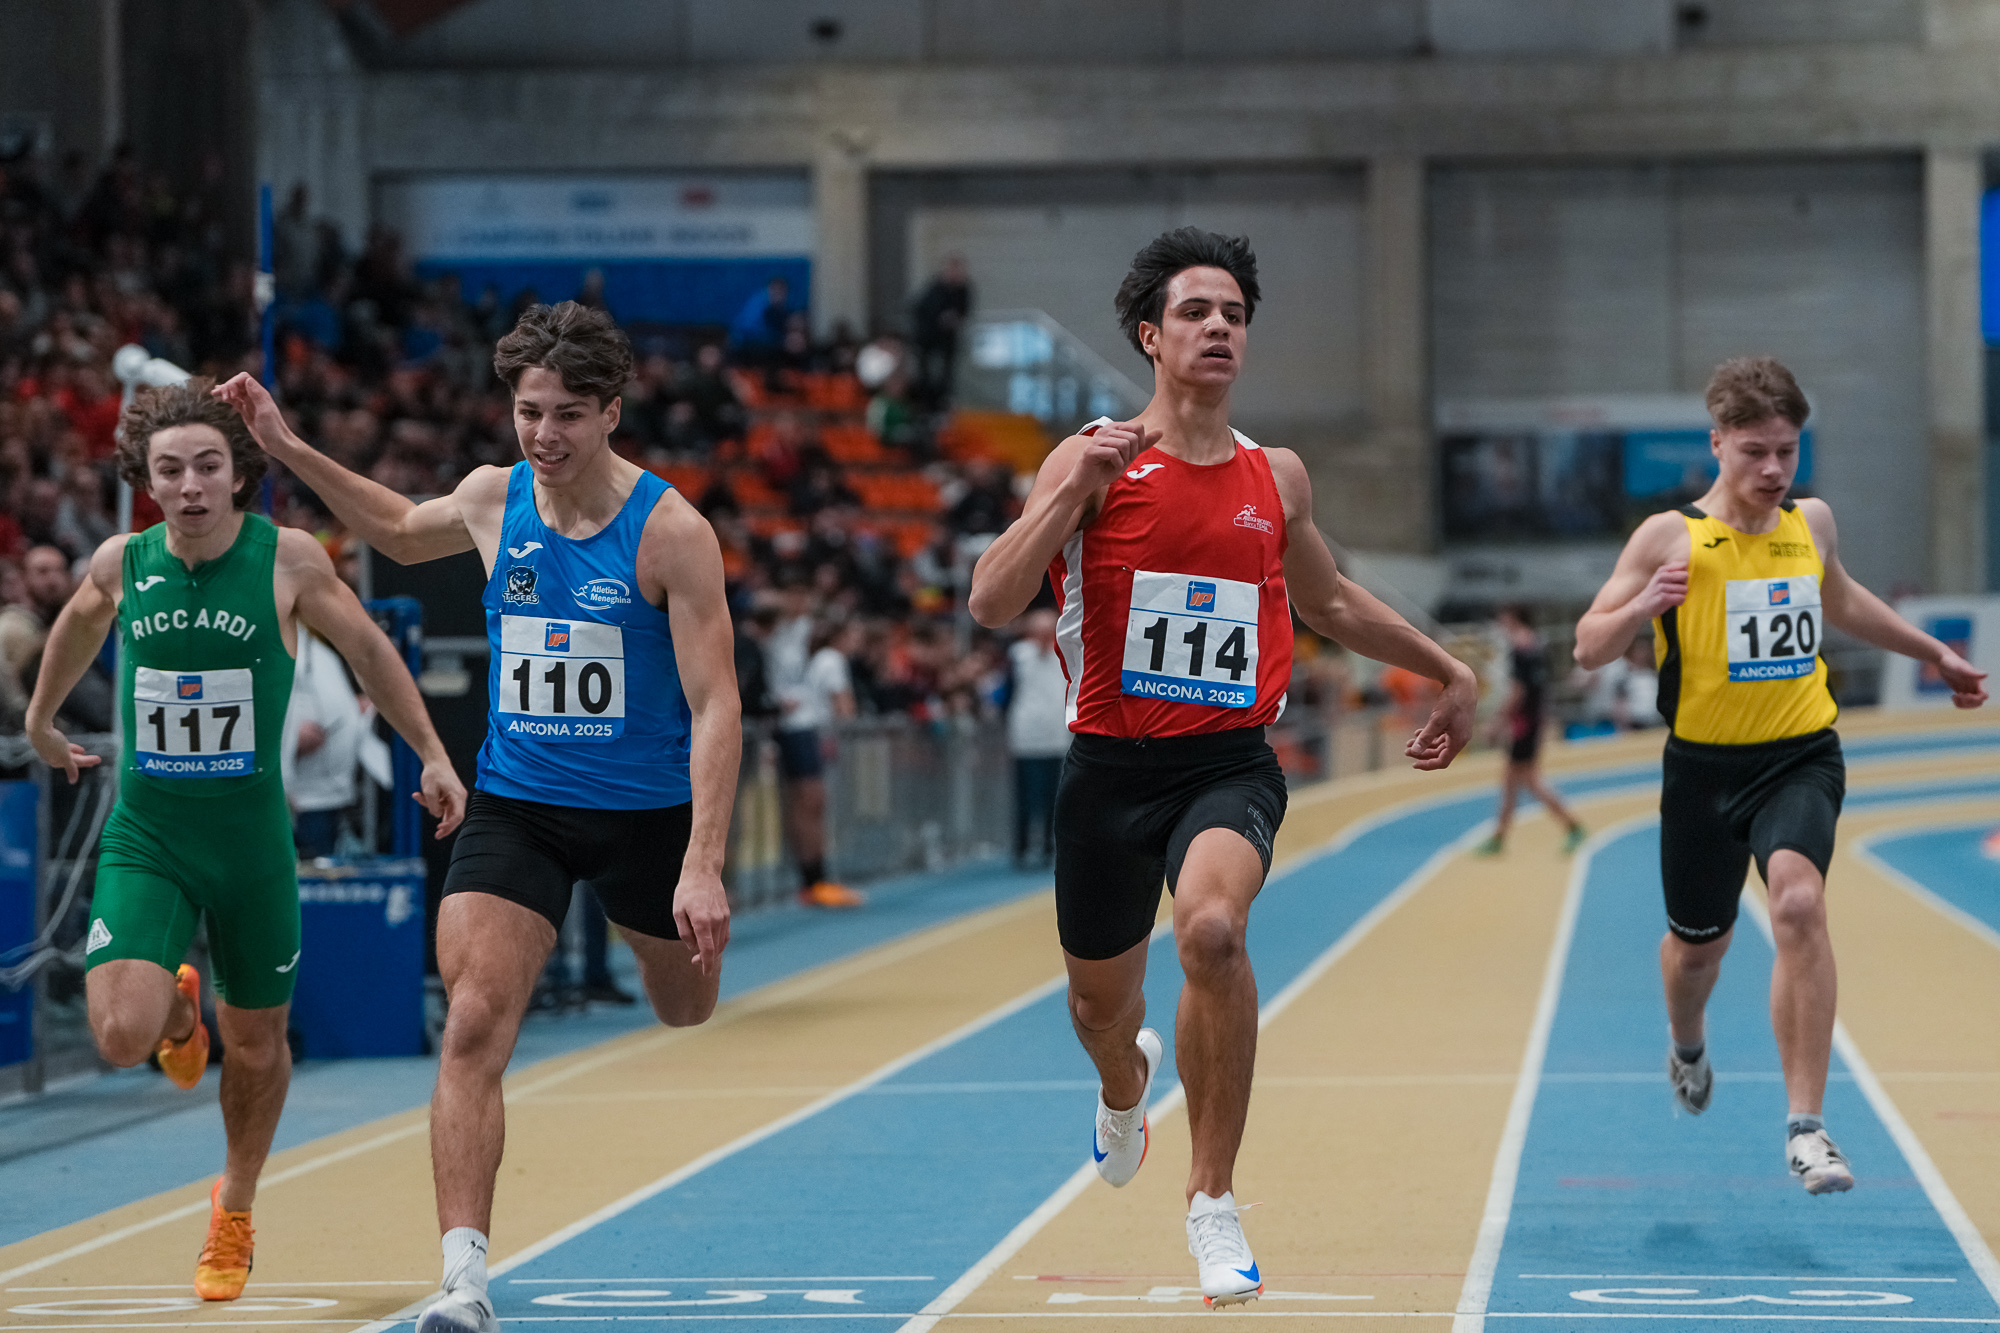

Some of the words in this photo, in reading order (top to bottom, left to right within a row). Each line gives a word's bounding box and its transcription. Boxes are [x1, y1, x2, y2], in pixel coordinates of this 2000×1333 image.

[590, 585, 618, 595] Atletica
[590, 593, 632, 604] Meneghina
[1190, 592, 1213, 606] IP
[131, 608, 257, 641] RICCARDI
[547, 633, 568, 646] IP
[1740, 609, 1815, 659] 120
[1143, 616, 1249, 682] 114
[1739, 664, 1795, 678] ANCONA
[512, 658, 613, 715] 110
[1131, 679, 1204, 701] ANCONA
[1207, 689, 1246, 705] 2025
[148, 704, 241, 753] 117
[507, 720, 571, 736] ANCONA
[574, 723, 613, 737] 2025
[145, 758, 206, 773] ANCONA
[209, 758, 245, 771] 2025
[531, 1289, 866, 1307] 5
[1569, 1287, 1916, 1306] 3
